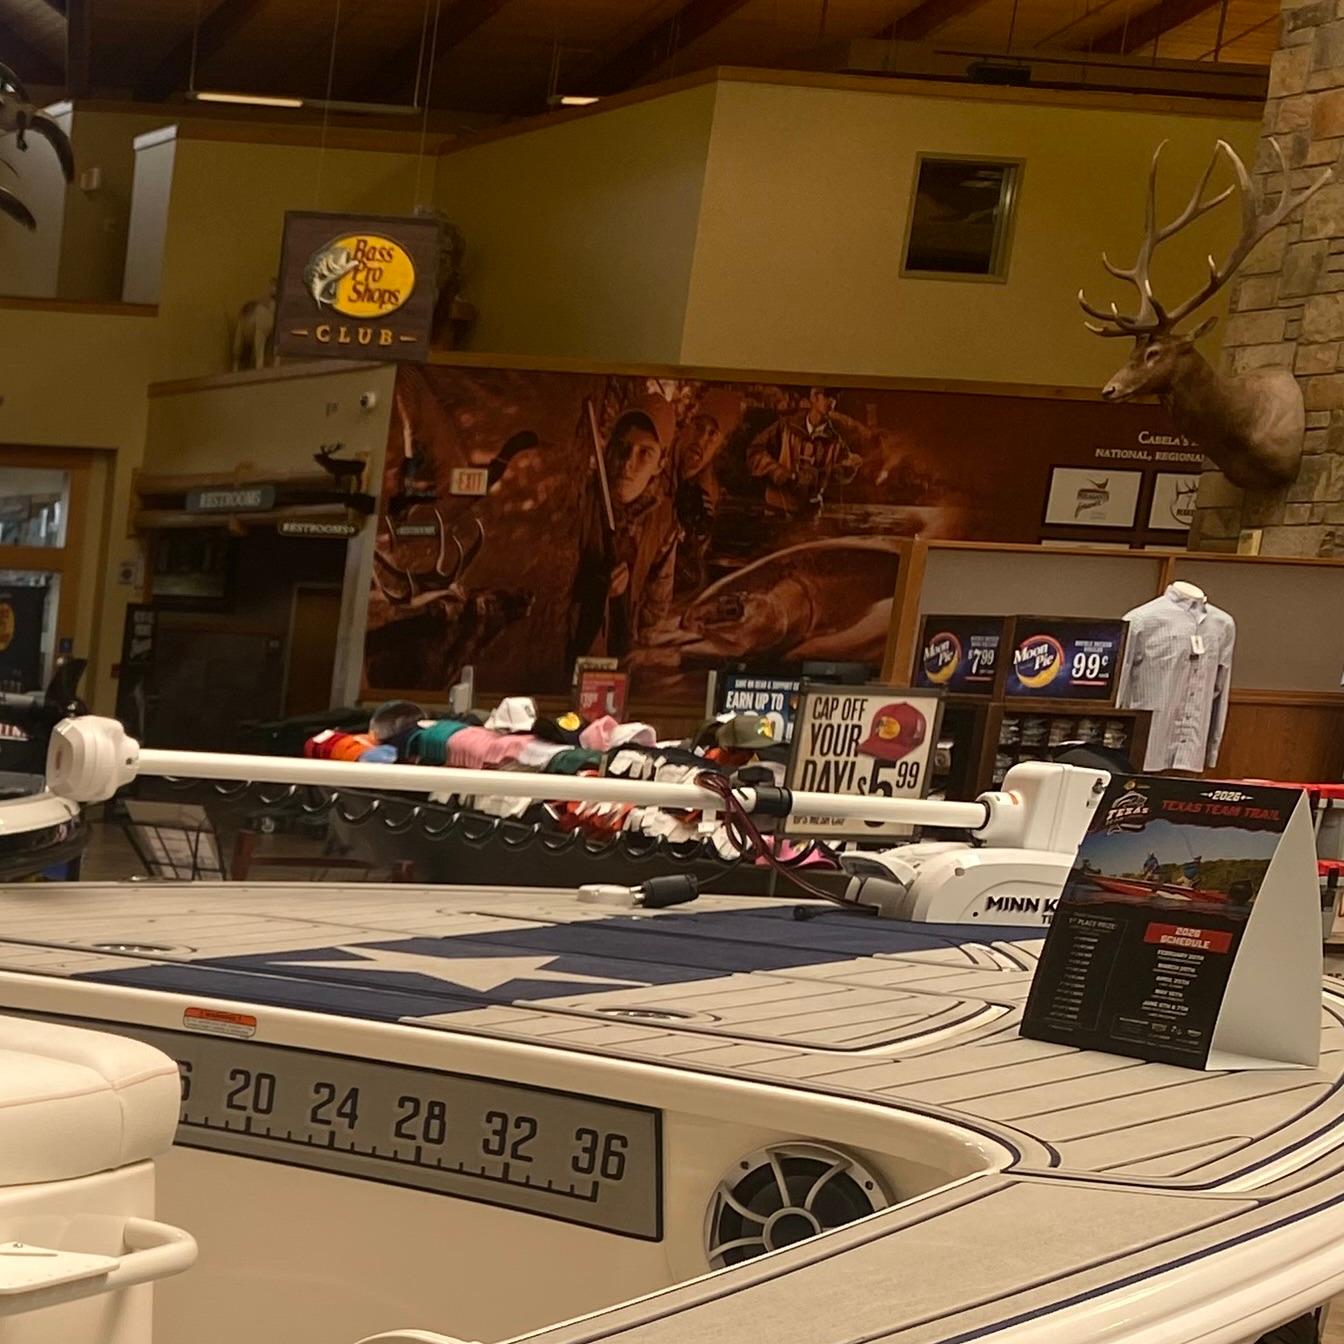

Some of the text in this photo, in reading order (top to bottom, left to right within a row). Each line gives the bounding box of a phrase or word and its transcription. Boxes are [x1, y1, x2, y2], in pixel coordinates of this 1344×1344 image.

[353, 239, 393, 262] Bass
[352, 261, 383, 282] Pro
[347, 282, 400, 309] Shops
[316, 325, 393, 346] CLUB
[199, 491, 260, 508] RESTROOMS
[282, 522, 347, 535] RESTROOMS
[923, 641, 949, 661] Moon
[937, 651, 953, 667] Pie
[1013, 643, 1048, 665] Moon
[1033, 653, 1054, 670] Pie
[726, 691, 784, 711] EARN UP TO
[813, 697, 868, 722] CAP OFF
[810, 722, 862, 757] YOUR
[801, 759, 856, 794] DAY!
[1105, 807, 1150, 821] TEXAS
[1161, 800, 1282, 821] TEXAS TEAM TRAIL
[985, 896, 1040, 912] MINN
[1160, 935, 1211, 949] SCHEDULE
[226, 1068, 276, 1115] 20
[311, 1082, 359, 1130] 24
[395, 1096, 446, 1146] 28
[483, 1111, 538, 1163] 32
[572, 1127, 629, 1181] 36
